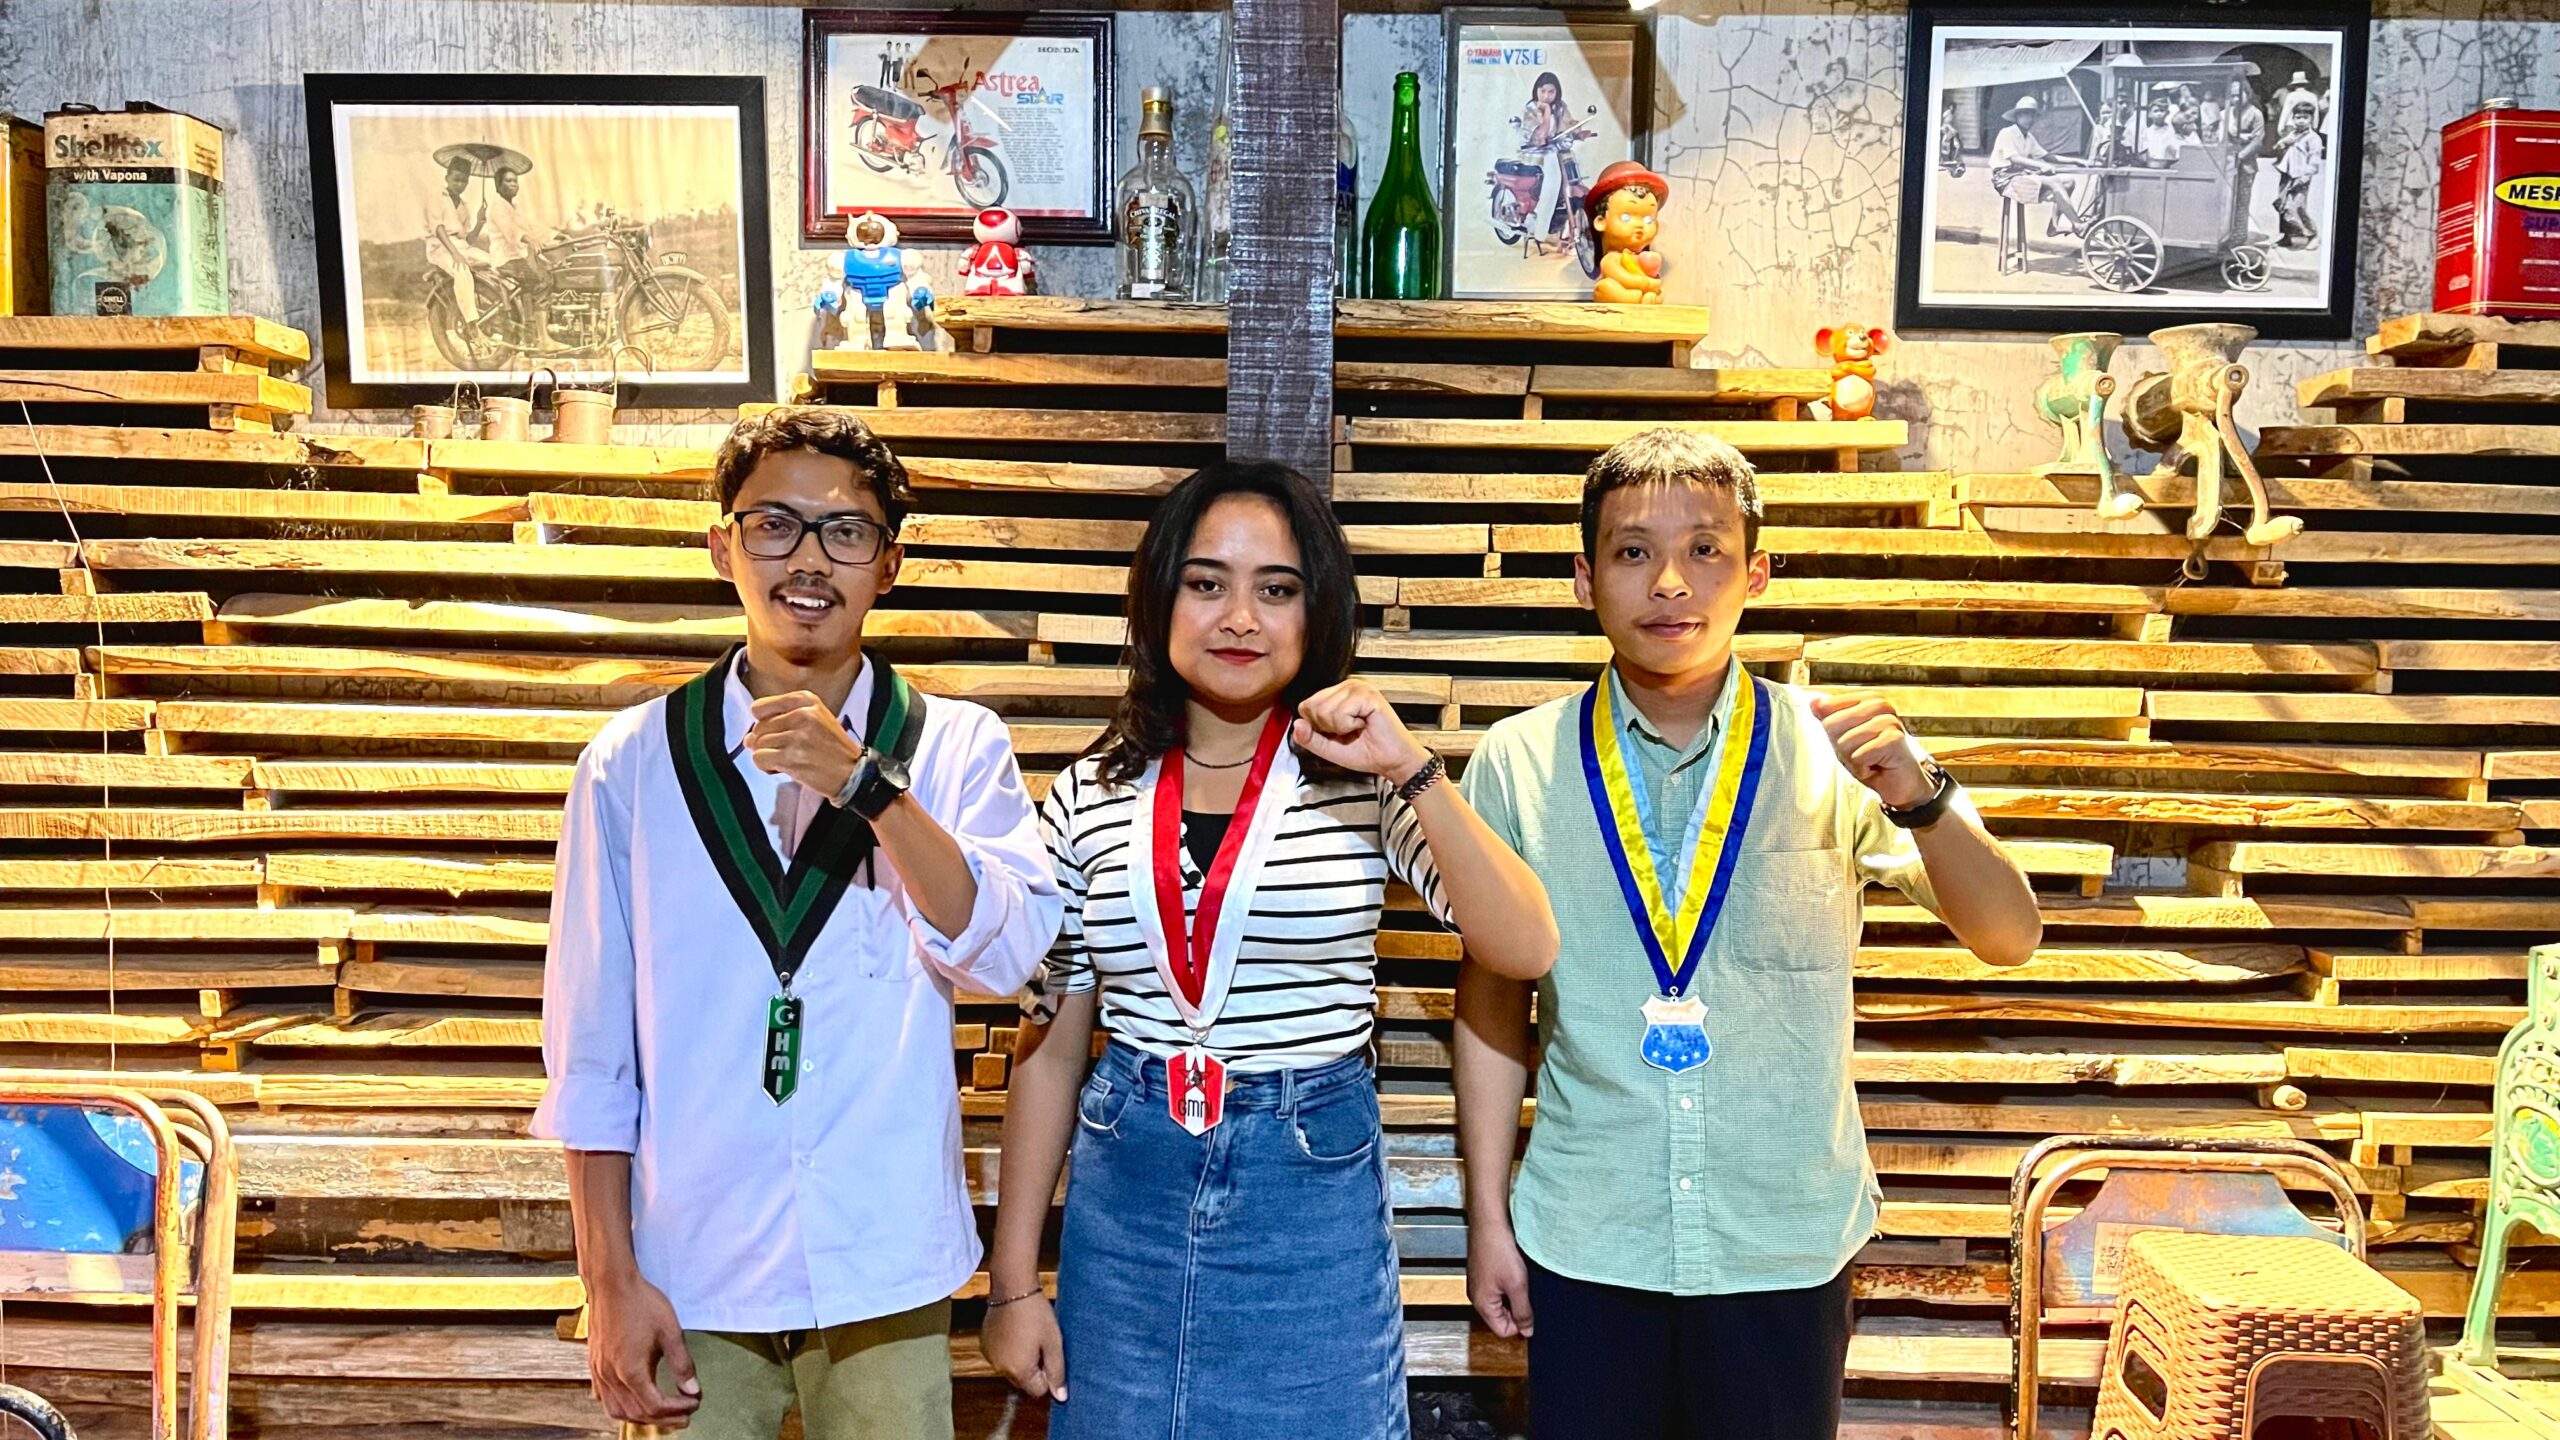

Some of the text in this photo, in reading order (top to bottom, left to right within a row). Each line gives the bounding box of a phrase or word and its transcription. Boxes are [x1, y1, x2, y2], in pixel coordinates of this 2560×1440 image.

[970, 70, 1040, 97] Astrea
[1016, 86, 1064, 105] STAR
[73, 169, 147, 182] with Vapona
